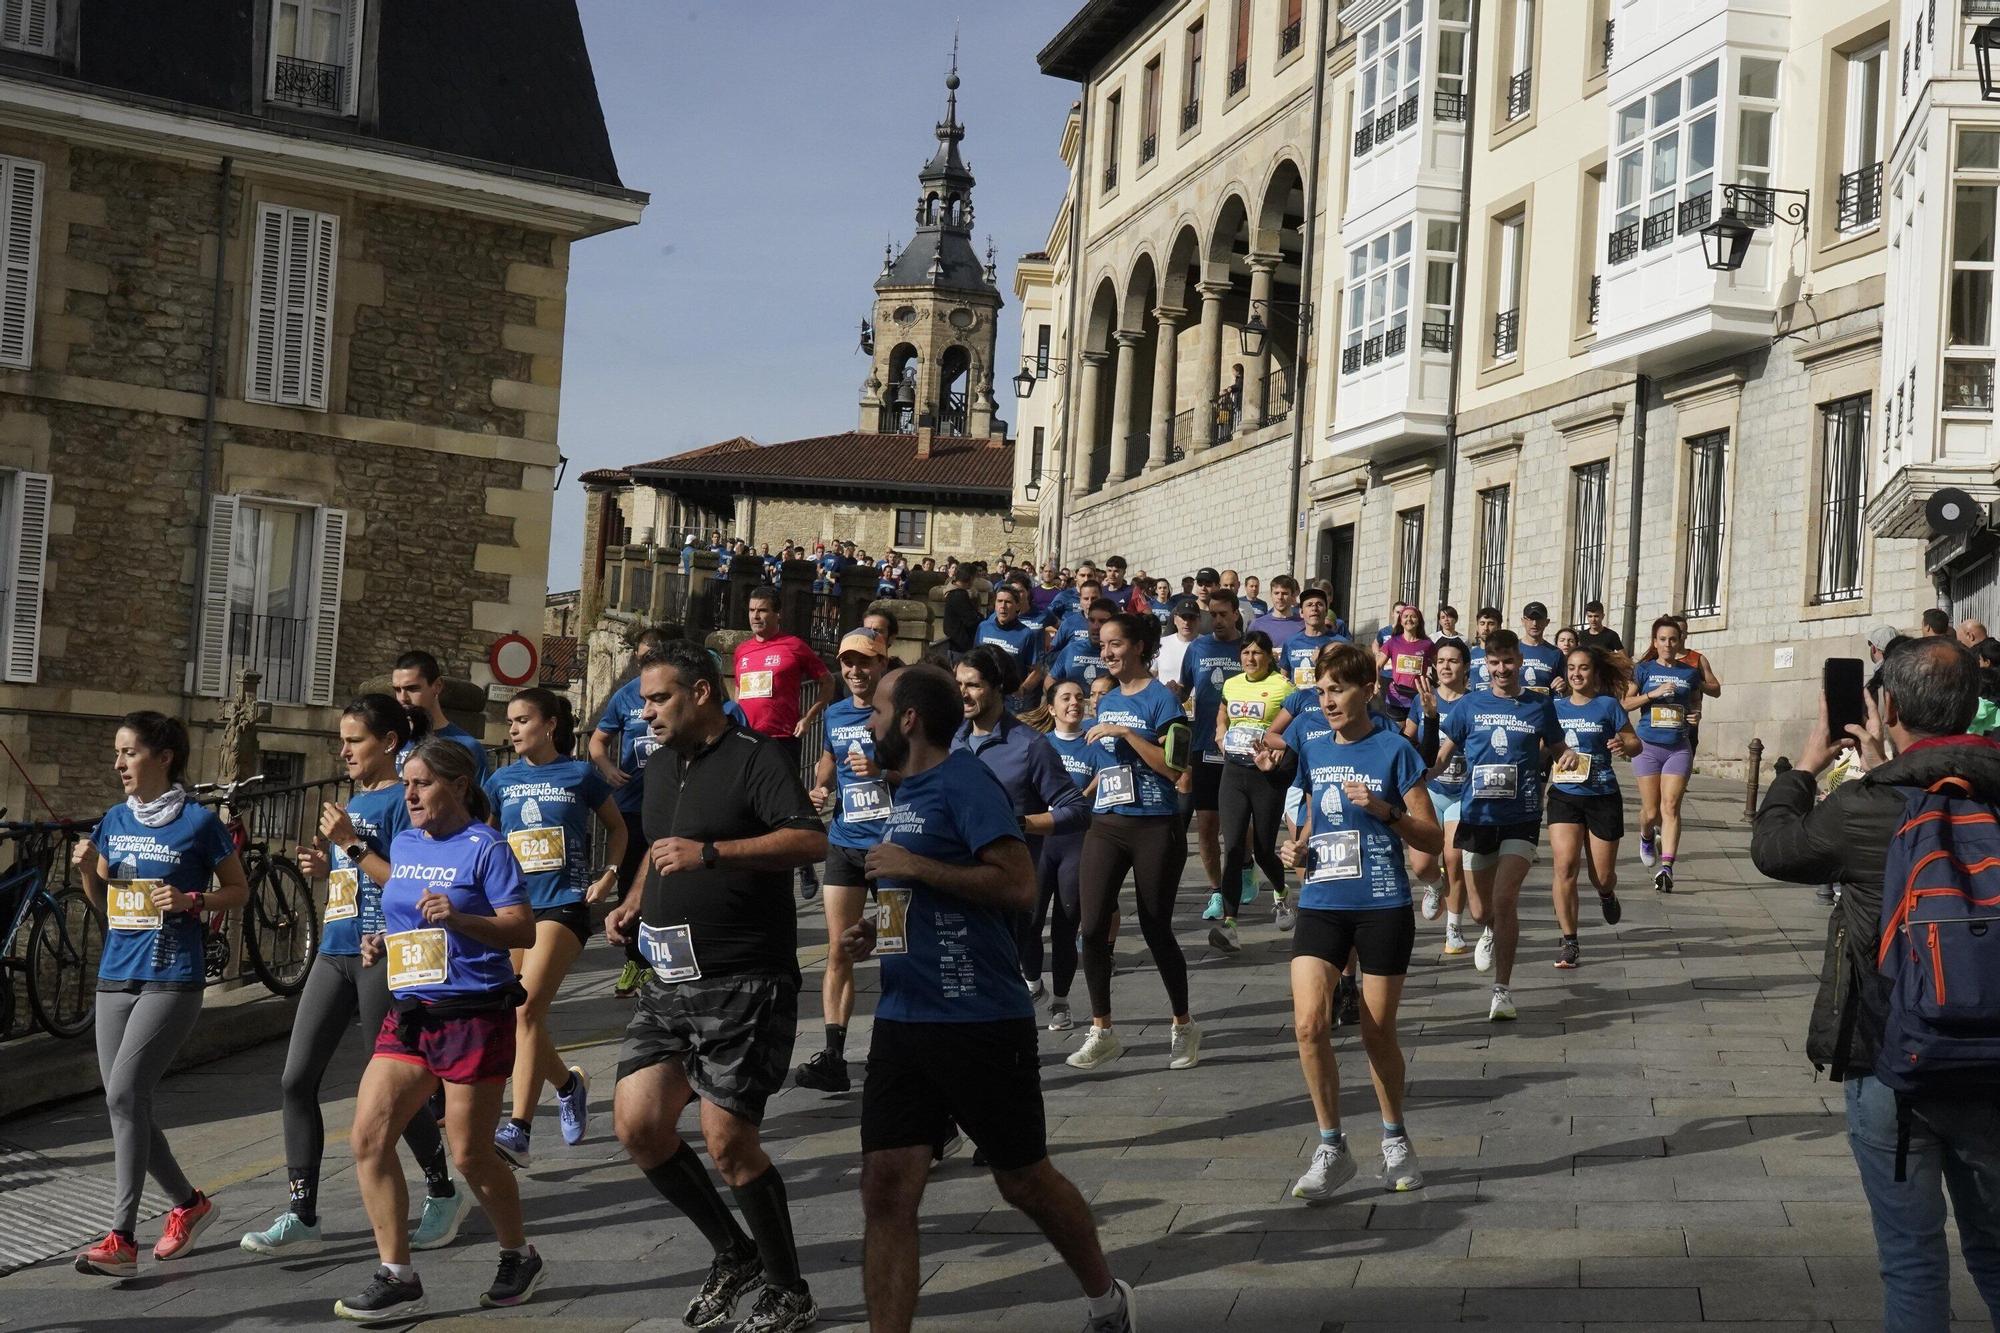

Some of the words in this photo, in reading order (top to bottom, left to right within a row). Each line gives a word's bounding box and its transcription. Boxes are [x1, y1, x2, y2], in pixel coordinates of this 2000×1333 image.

[1482, 718, 1528, 727] ALMENDRA
[1316, 766, 1354, 774] CONQUISTA
[1314, 772, 1371, 784] ALMENDRA
[510, 782, 551, 792] CONQUISTA
[510, 787, 566, 798] ALMENDRA
[538, 795, 576, 804] KONKISTA
[851, 790, 880, 808] 1014
[116, 835, 156, 844] CONQUISTA
[114, 842, 170, 855] ALMENDRA
[520, 838, 550, 856] 628
[138, 852, 181, 864] KONKISTA
[428, 880, 452, 888] group
[116, 892, 144, 910] 430
[402, 944, 422, 966] 53
[648, 940, 672, 962] 774
